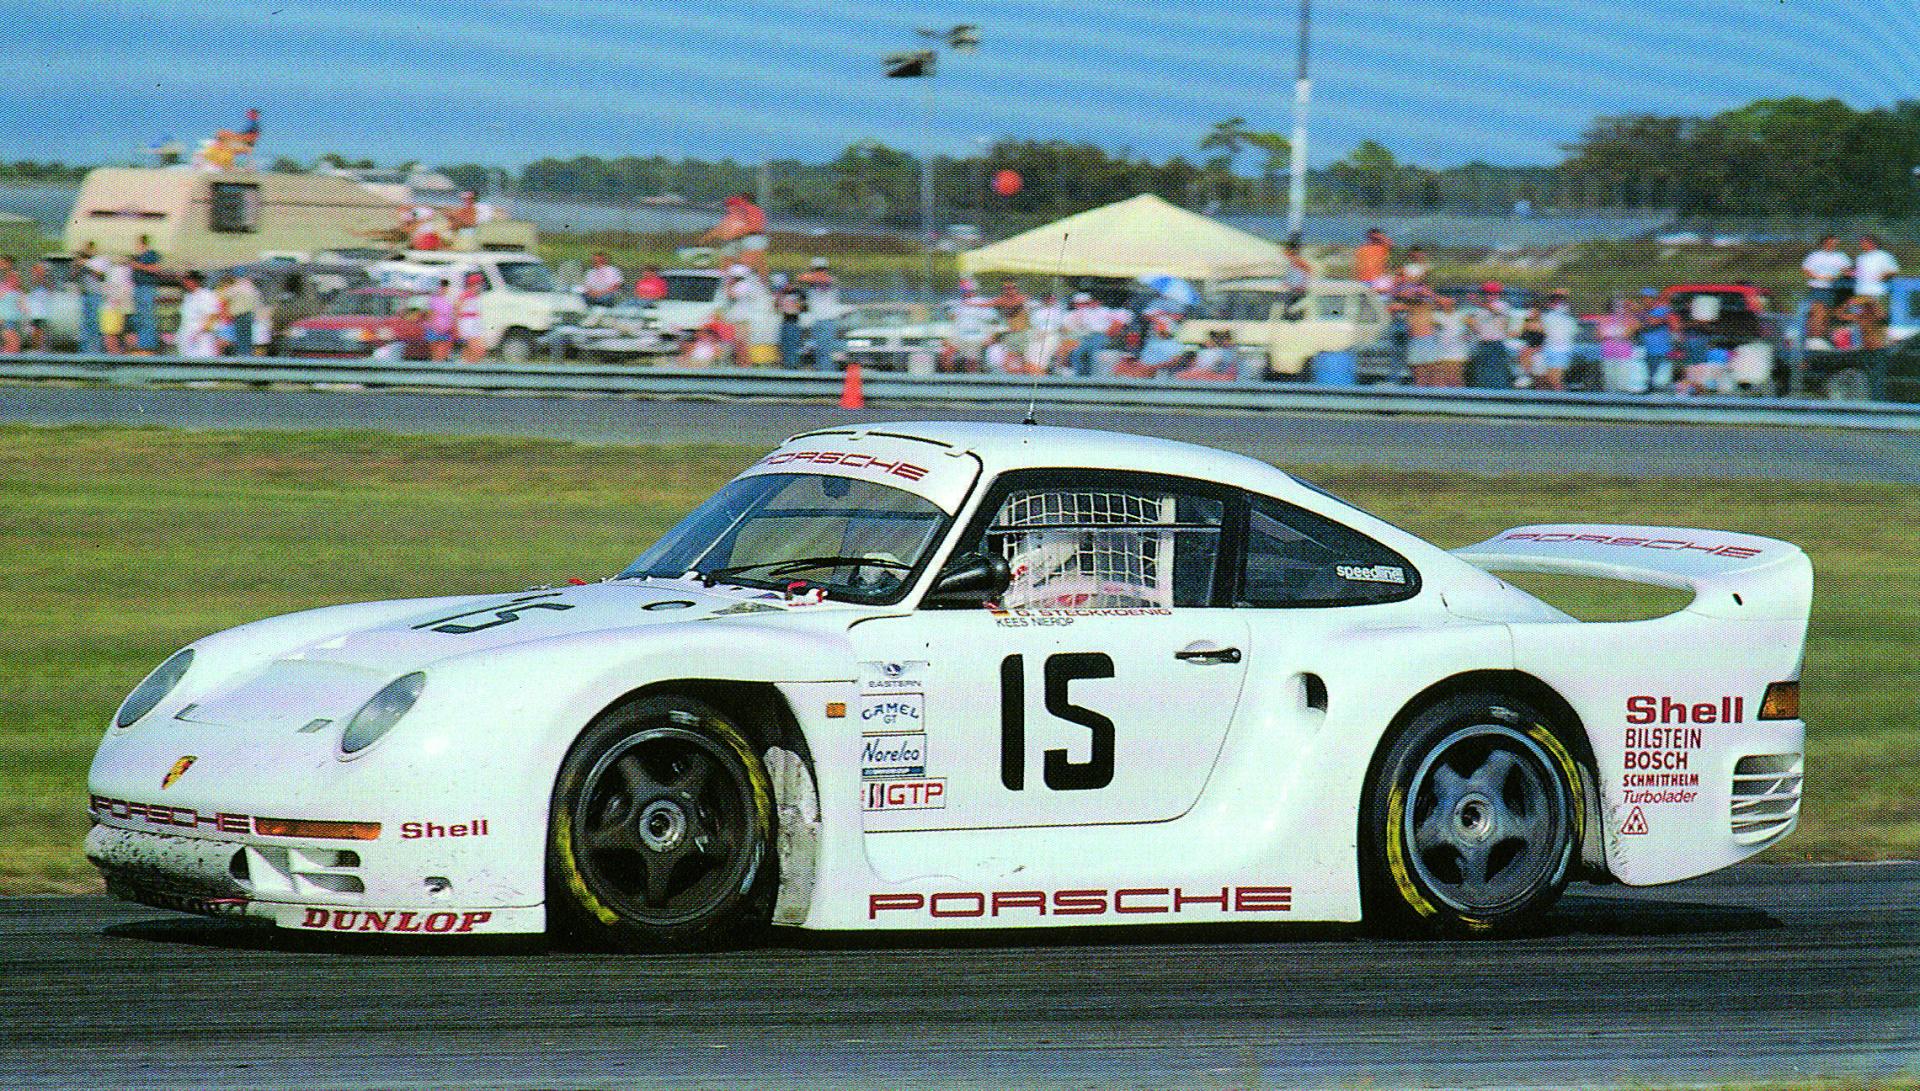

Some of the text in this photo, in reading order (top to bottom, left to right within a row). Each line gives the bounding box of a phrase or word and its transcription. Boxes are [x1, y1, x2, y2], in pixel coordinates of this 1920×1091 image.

[1504, 533, 1764, 559] PORSCHE
[411, 593, 575, 634] 15
[995, 617, 1029, 628] KEES
[861, 702, 920, 720] CAMEL
[882, 714, 898, 725] GT
[1626, 695, 1744, 724] Shell
[1000, 652, 1116, 792] 15
[861, 738, 920, 763] Norelco
[1624, 728, 1702, 749] BILSTEIN
[1623, 751, 1689, 770] BOSCH
[887, 782, 943, 805] GTP
[1623, 790, 1698, 804] Turbolader
[90, 794, 250, 834] PORSCHE
[400, 819, 489, 839] Shell
[868, 886, 1292, 920] PORSCHE
[302, 907, 492, 933] DUNLOP
